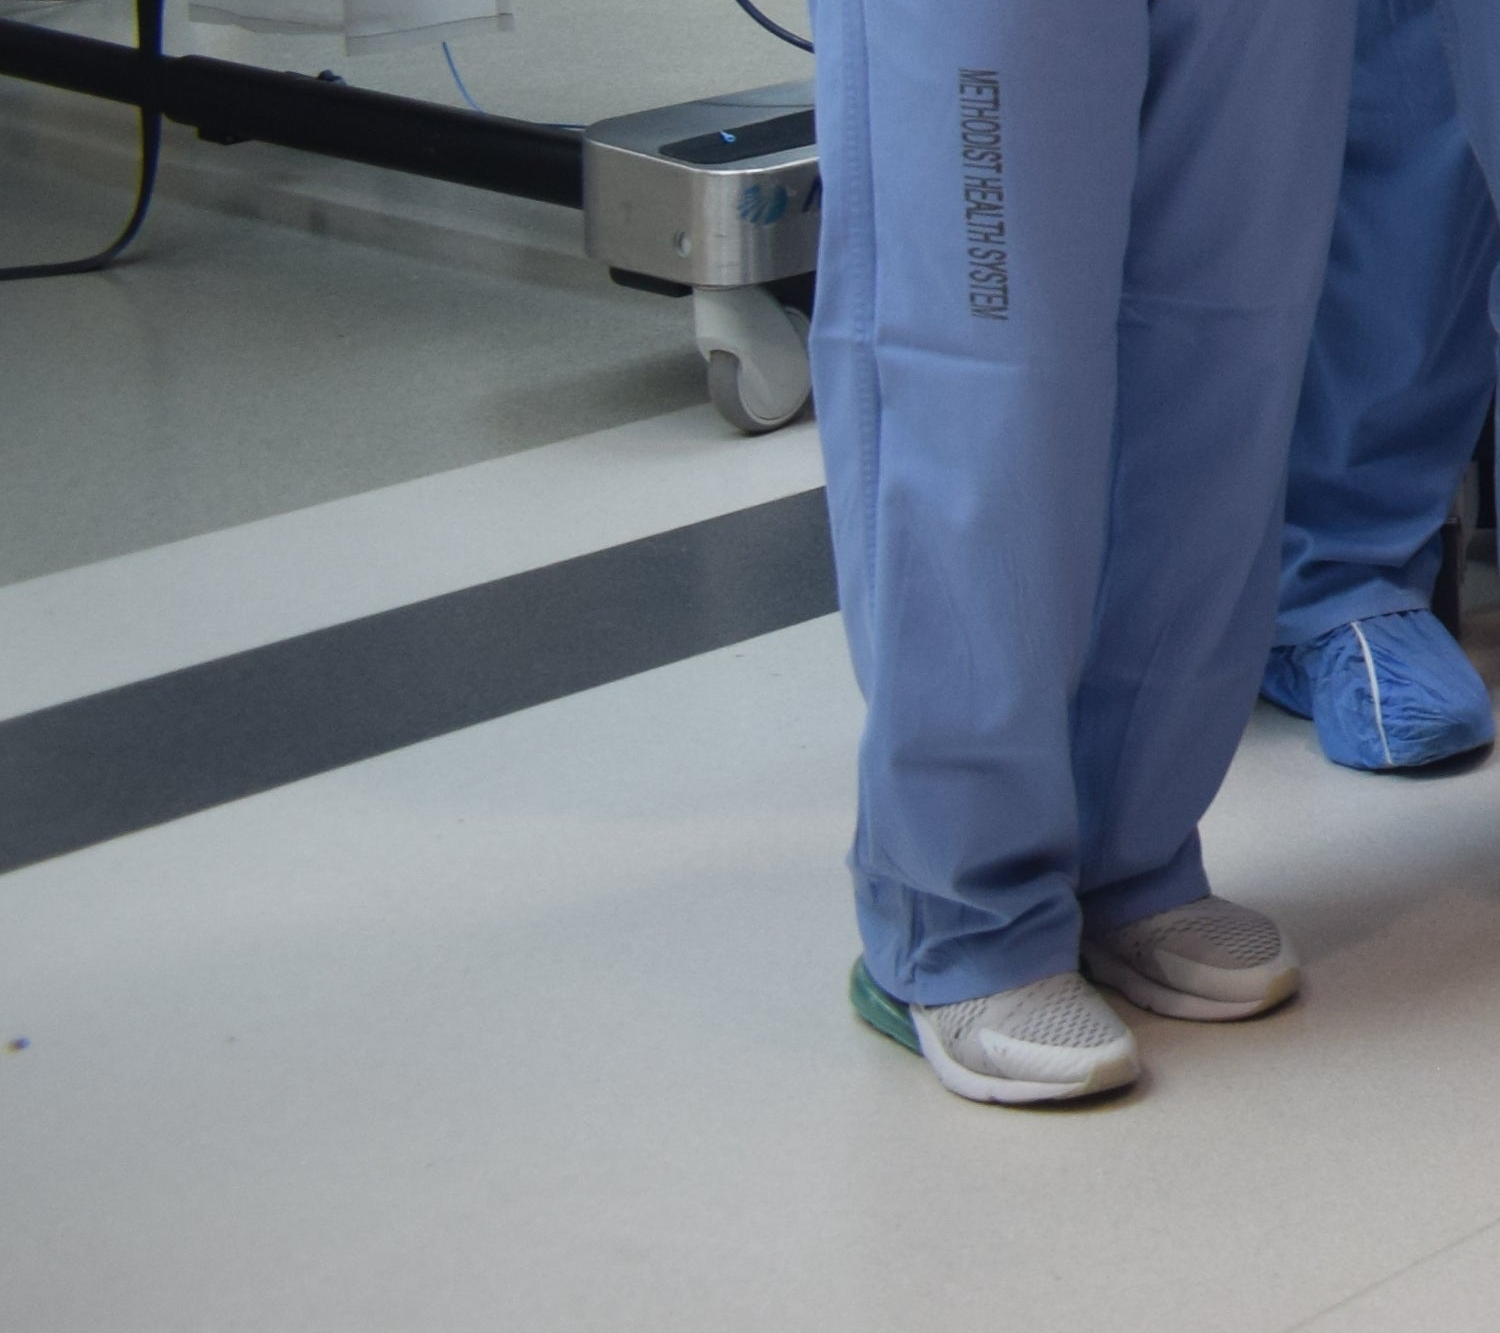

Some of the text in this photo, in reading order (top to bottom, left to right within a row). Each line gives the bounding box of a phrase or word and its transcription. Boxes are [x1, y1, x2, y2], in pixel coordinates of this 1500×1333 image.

[958, 68, 1010, 321] METHODIST HEALTH SYSTEM
